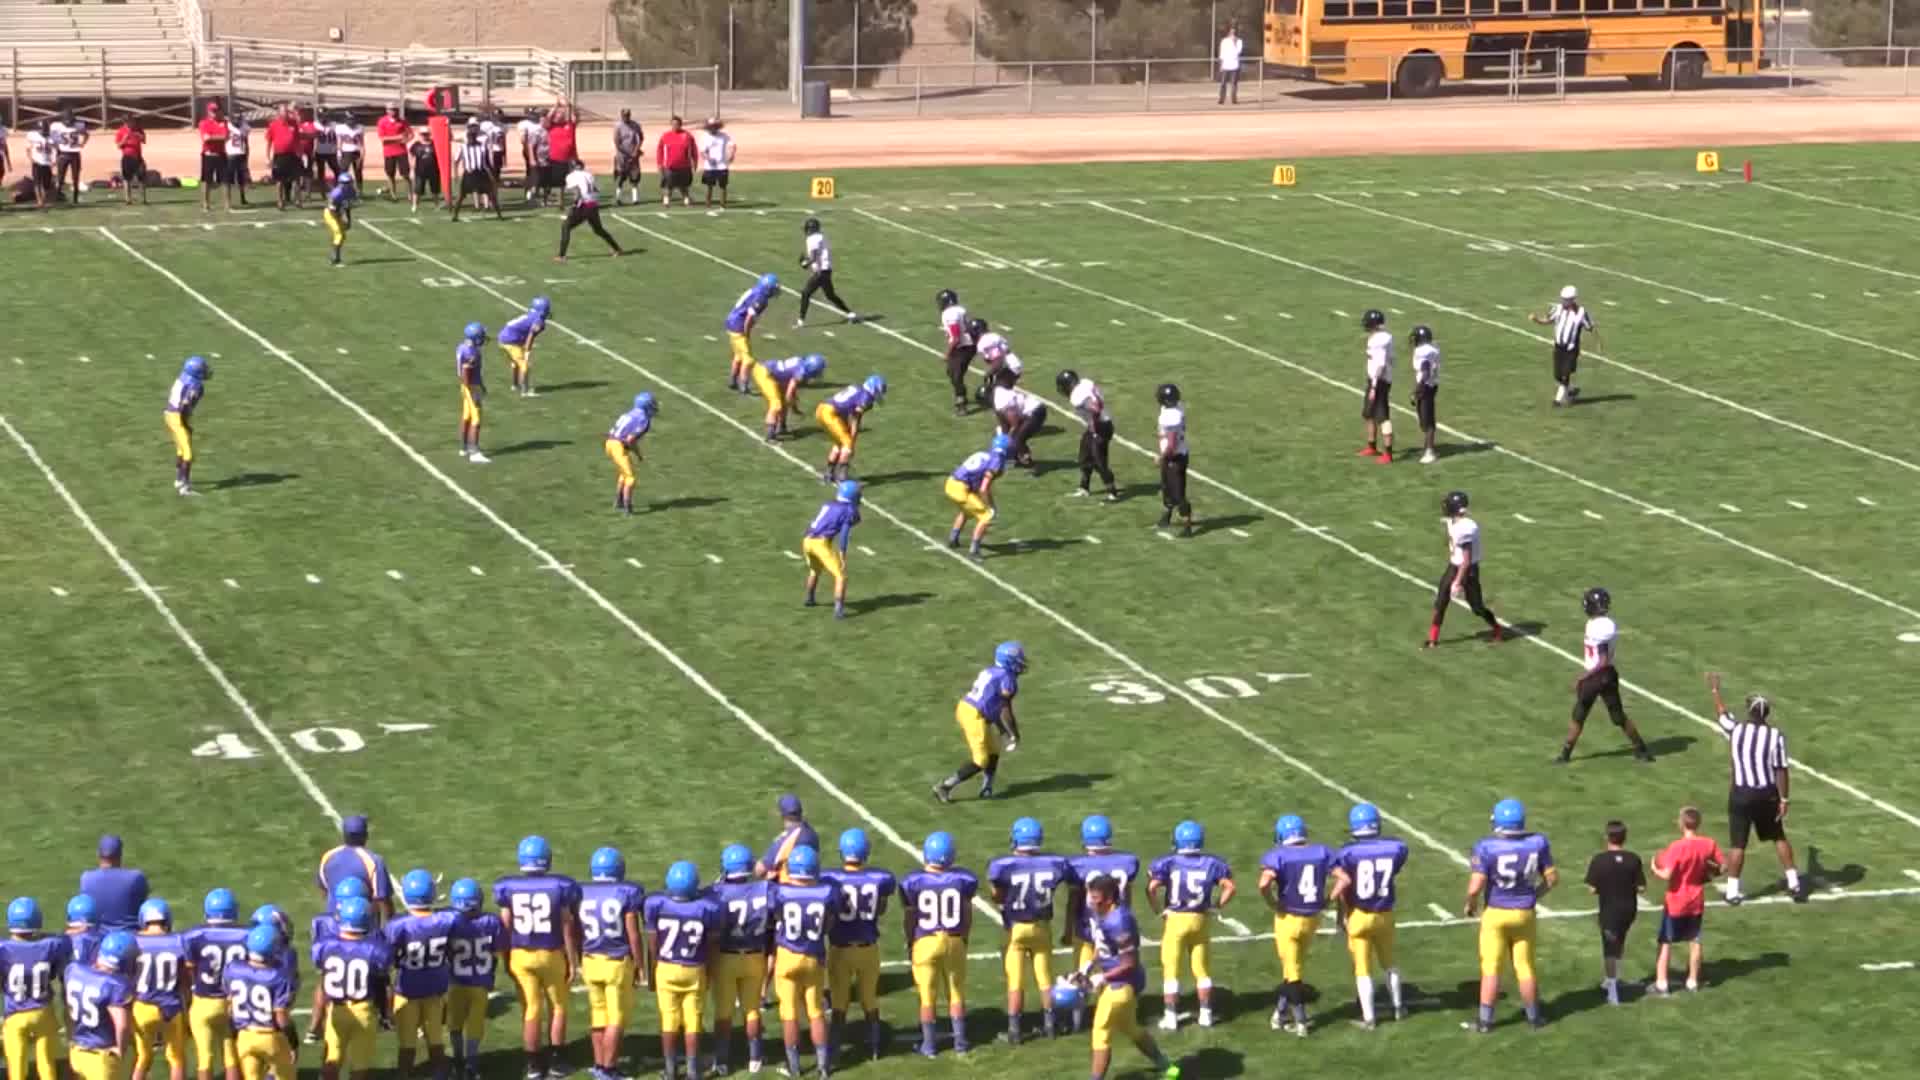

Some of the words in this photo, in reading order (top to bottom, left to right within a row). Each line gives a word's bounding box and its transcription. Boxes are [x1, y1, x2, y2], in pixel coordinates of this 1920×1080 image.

[1280, 167, 1294, 183] 10
[1704, 154, 1714, 168] G
[817, 180, 832, 195] 20
[1010, 871, 1054, 910] 75
[1169, 869, 1207, 907] 15
[1299, 864, 1317, 903] 4
[1496, 852, 1541, 889] 54
[512, 892, 552, 935] 52
[579, 898, 623, 940] 59
[783, 901, 825, 941] 83
[918, 887, 961, 930] 90
[406, 936, 448, 970] 85
[453, 935, 492, 976] 25
[657, 917, 705, 959] 73
[8, 961, 51, 1002] 40
[324, 955, 369, 999] 20
[66, 979, 99, 1028] 55
[229, 979, 273, 1022] 29
